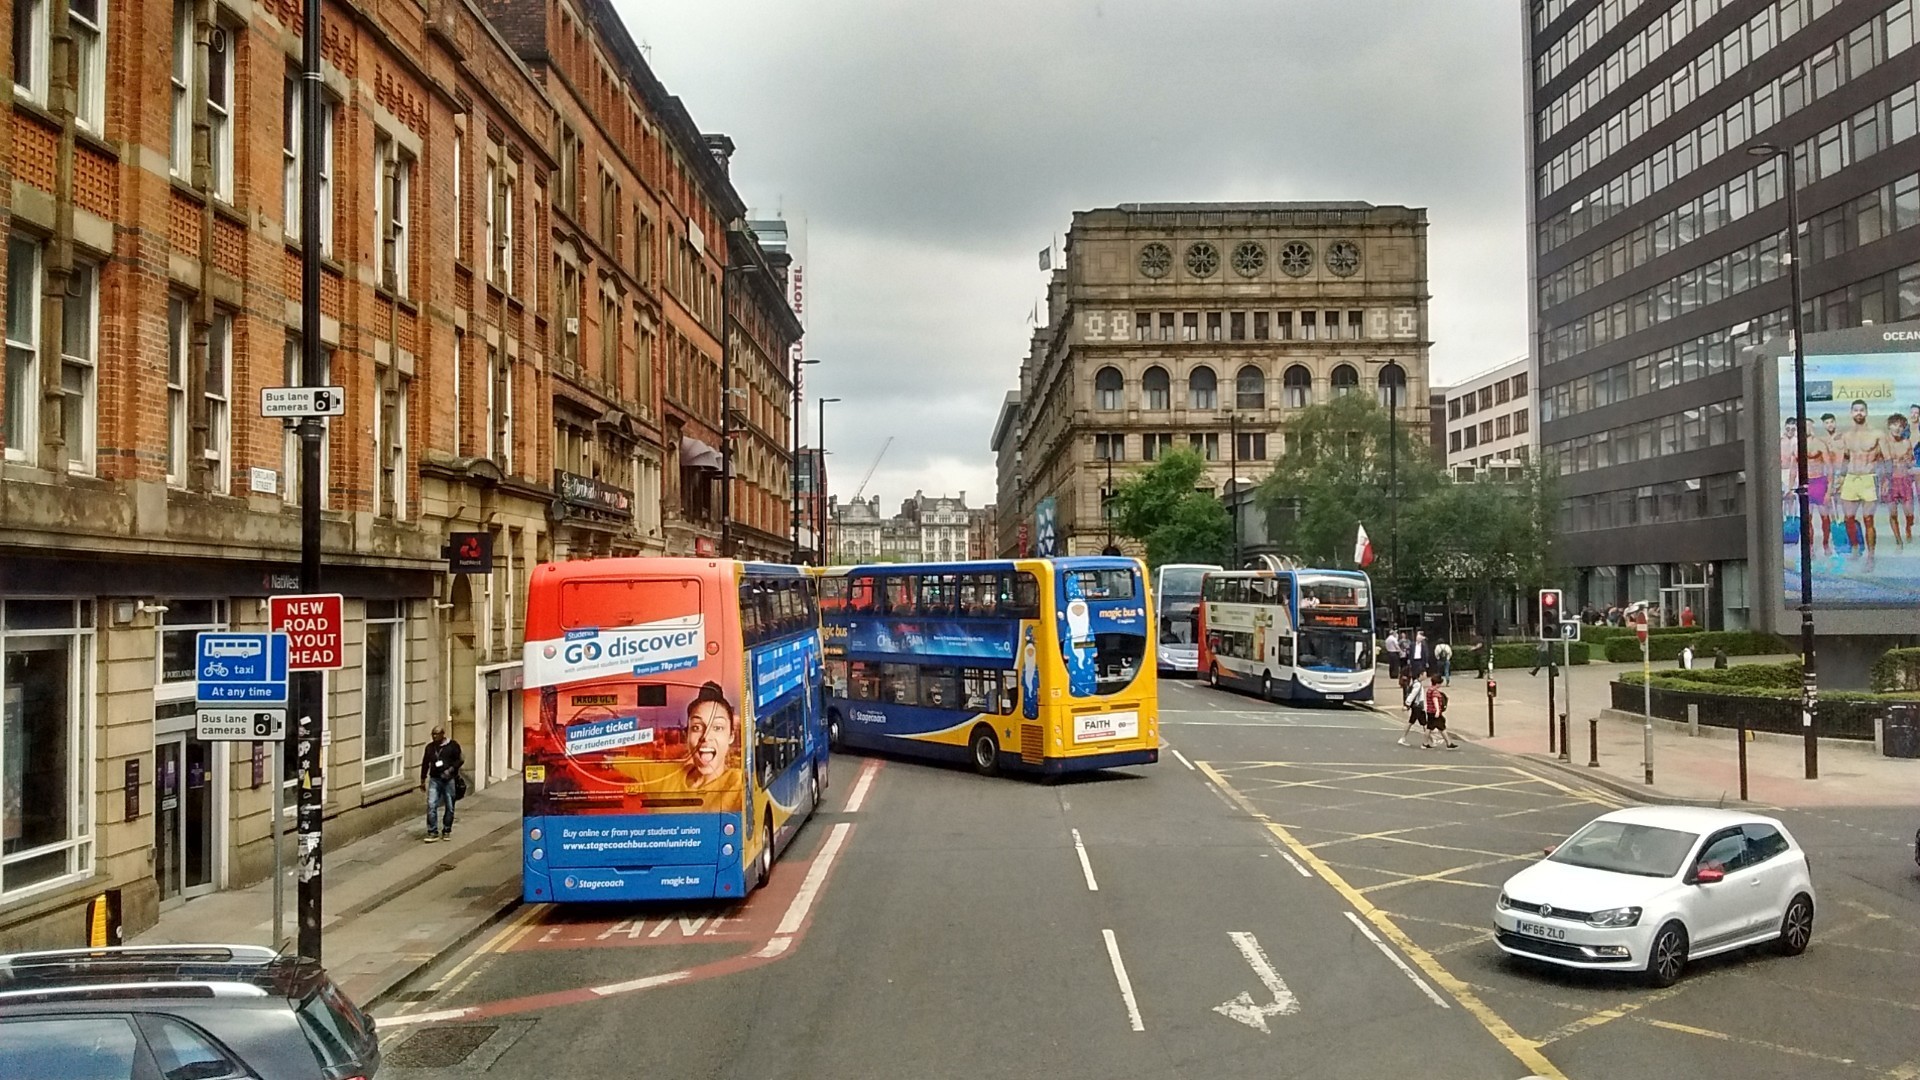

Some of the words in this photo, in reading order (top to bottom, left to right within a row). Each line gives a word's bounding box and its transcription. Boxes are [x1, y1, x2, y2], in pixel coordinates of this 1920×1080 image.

[794, 265, 803, 314] HOTEL
[1882, 330, 1920, 341] OCEAN
[265, 392, 285, 401] Bus
[287, 392, 309, 401] lane
[1836, 383, 1892, 399] Arrivals
[271, 574, 300, 589] NatWest
[287, 602, 324, 615] NEW
[1099, 606, 1122, 621] magic
[1122, 607, 1137, 618] bus
[283, 618, 328, 631] ROAD
[835, 624, 848, 638] bus
[287, 633, 336, 647] AYOUT
[564, 641, 602, 664] GO
[608, 630, 698, 658] discover
[289, 650, 334, 664] HEAD
[234, 665, 254, 674] taxi
[637, 666, 650, 674] from
[661, 662, 673, 671] 78p
[211, 687, 224, 696] At
[227, 688, 245, 697] any
[248, 686, 272, 696] time
[201, 714, 221, 723] Bus
[225, 714, 247, 723] lane
[857, 711, 887, 724] Stagecoach
[201, 727, 247, 735] cameras
[605, 720, 634, 733] ticket
[1084, 719, 1111, 730] FAITH
[570, 741, 582, 751] For
[584, 738, 616, 750] students
[617, 734, 636, 745] aged
[638, 731, 651, 740] 16+
[563, 829, 577, 839] Buy
[578, 828, 600, 838] online
[611, 828, 628, 838] from
[629, 829, 646, 839] your
[647, 826, 679, 836] students'
[680, 827, 701, 835] union
[563, 839, 702, 851] www.stagecoachbus.com/unirider
[579, 878, 625, 890] Stagecoach
[660, 877, 685, 887] magic
[686, 876, 700, 885] bus
[1521, 922, 1546, 936] MF66
